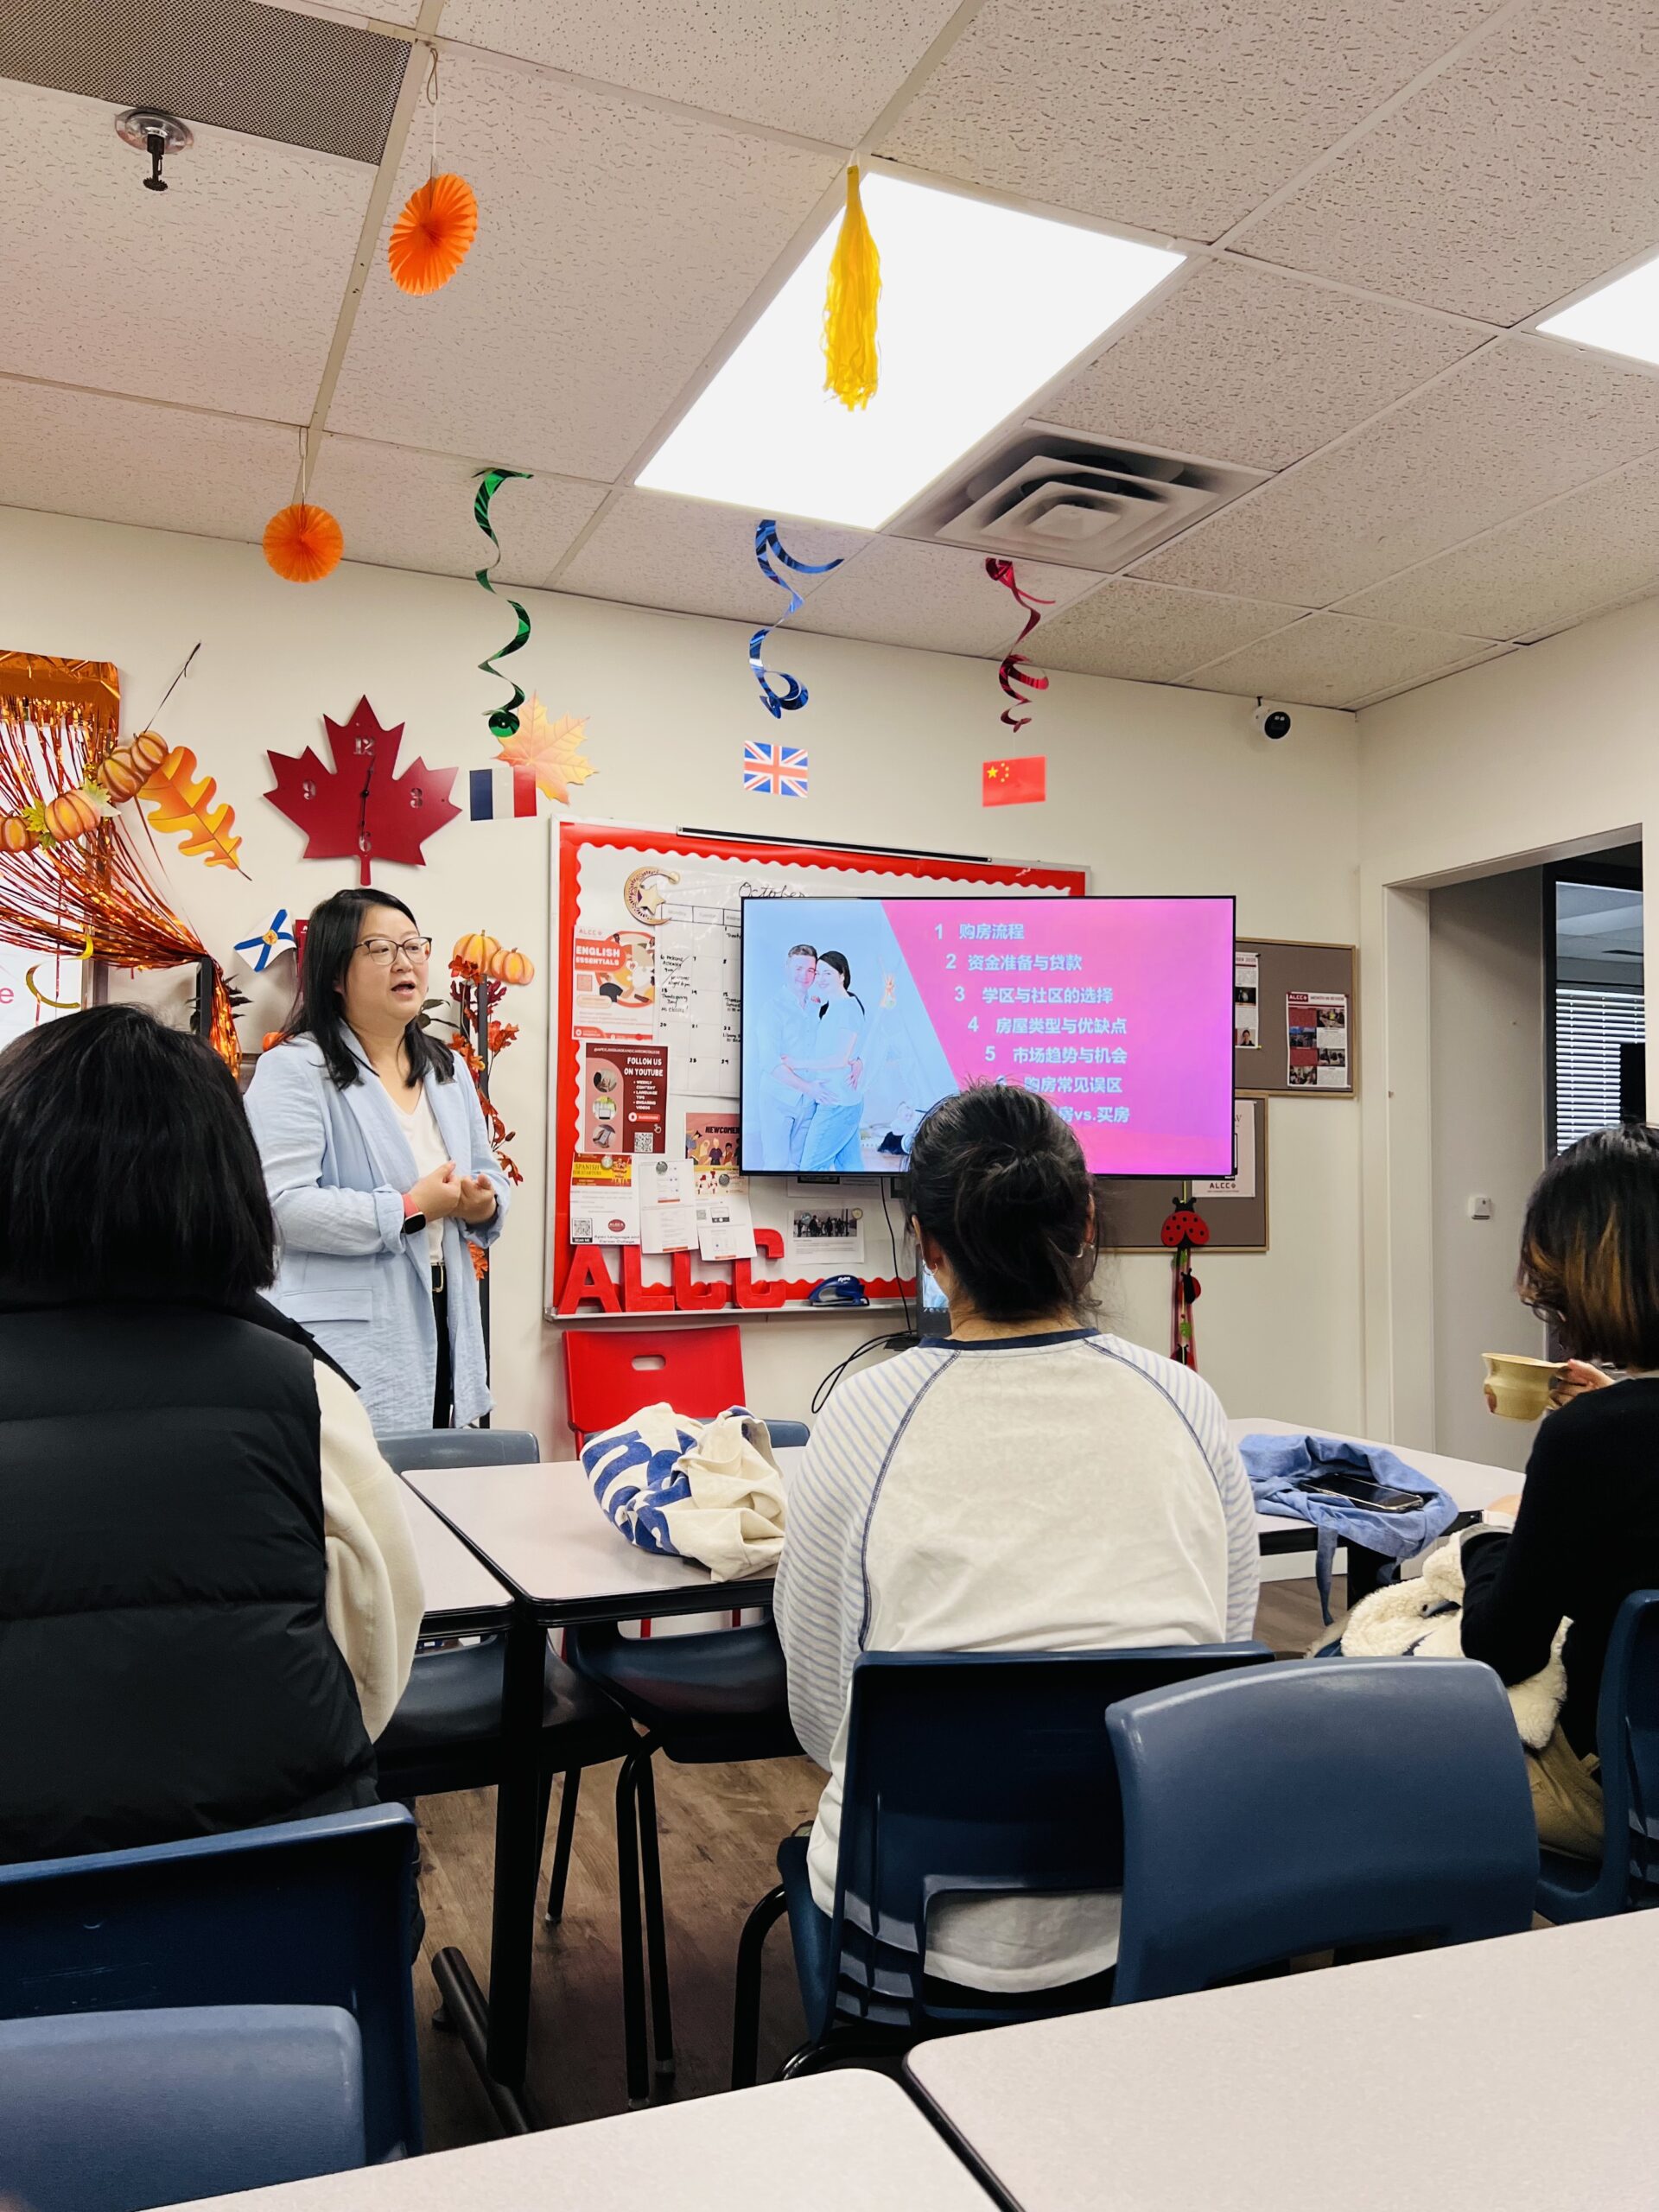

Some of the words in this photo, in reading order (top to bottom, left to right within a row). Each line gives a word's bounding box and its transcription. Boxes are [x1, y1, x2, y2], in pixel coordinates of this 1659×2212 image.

[302, 779, 316, 800] 9
[410, 787, 423, 809] 3
[359, 830, 372, 853] 6
[934, 923, 944, 940] 1
[959, 923, 1025, 940] 购房流程
[575, 945, 620, 958] ENGLISH
[575, 957, 620, 966] ESSENTIALS
[945, 953, 957, 969] 2
[968, 954, 1083, 971] 资金准备与贷款
[954, 985, 965, 1002] 3
[982, 987, 1113, 1004] 学区与社区的选择
[967, 1015, 979, 1033] 4
[995, 1017, 1127, 1034] 房屋类型与优缺点
[627, 1057, 652, 1066] FOLLOW
[985, 1046, 995, 1062] 5
[1013, 1047, 1128, 1064] 市场趋势与机会
[624, 1067, 633, 1076] ON
[635, 1068, 664, 1077] YOUTUBE
[1024, 1077, 1123, 1093] 购房常见误区
[1052, 1106, 1129, 1123] 房vs.买房
